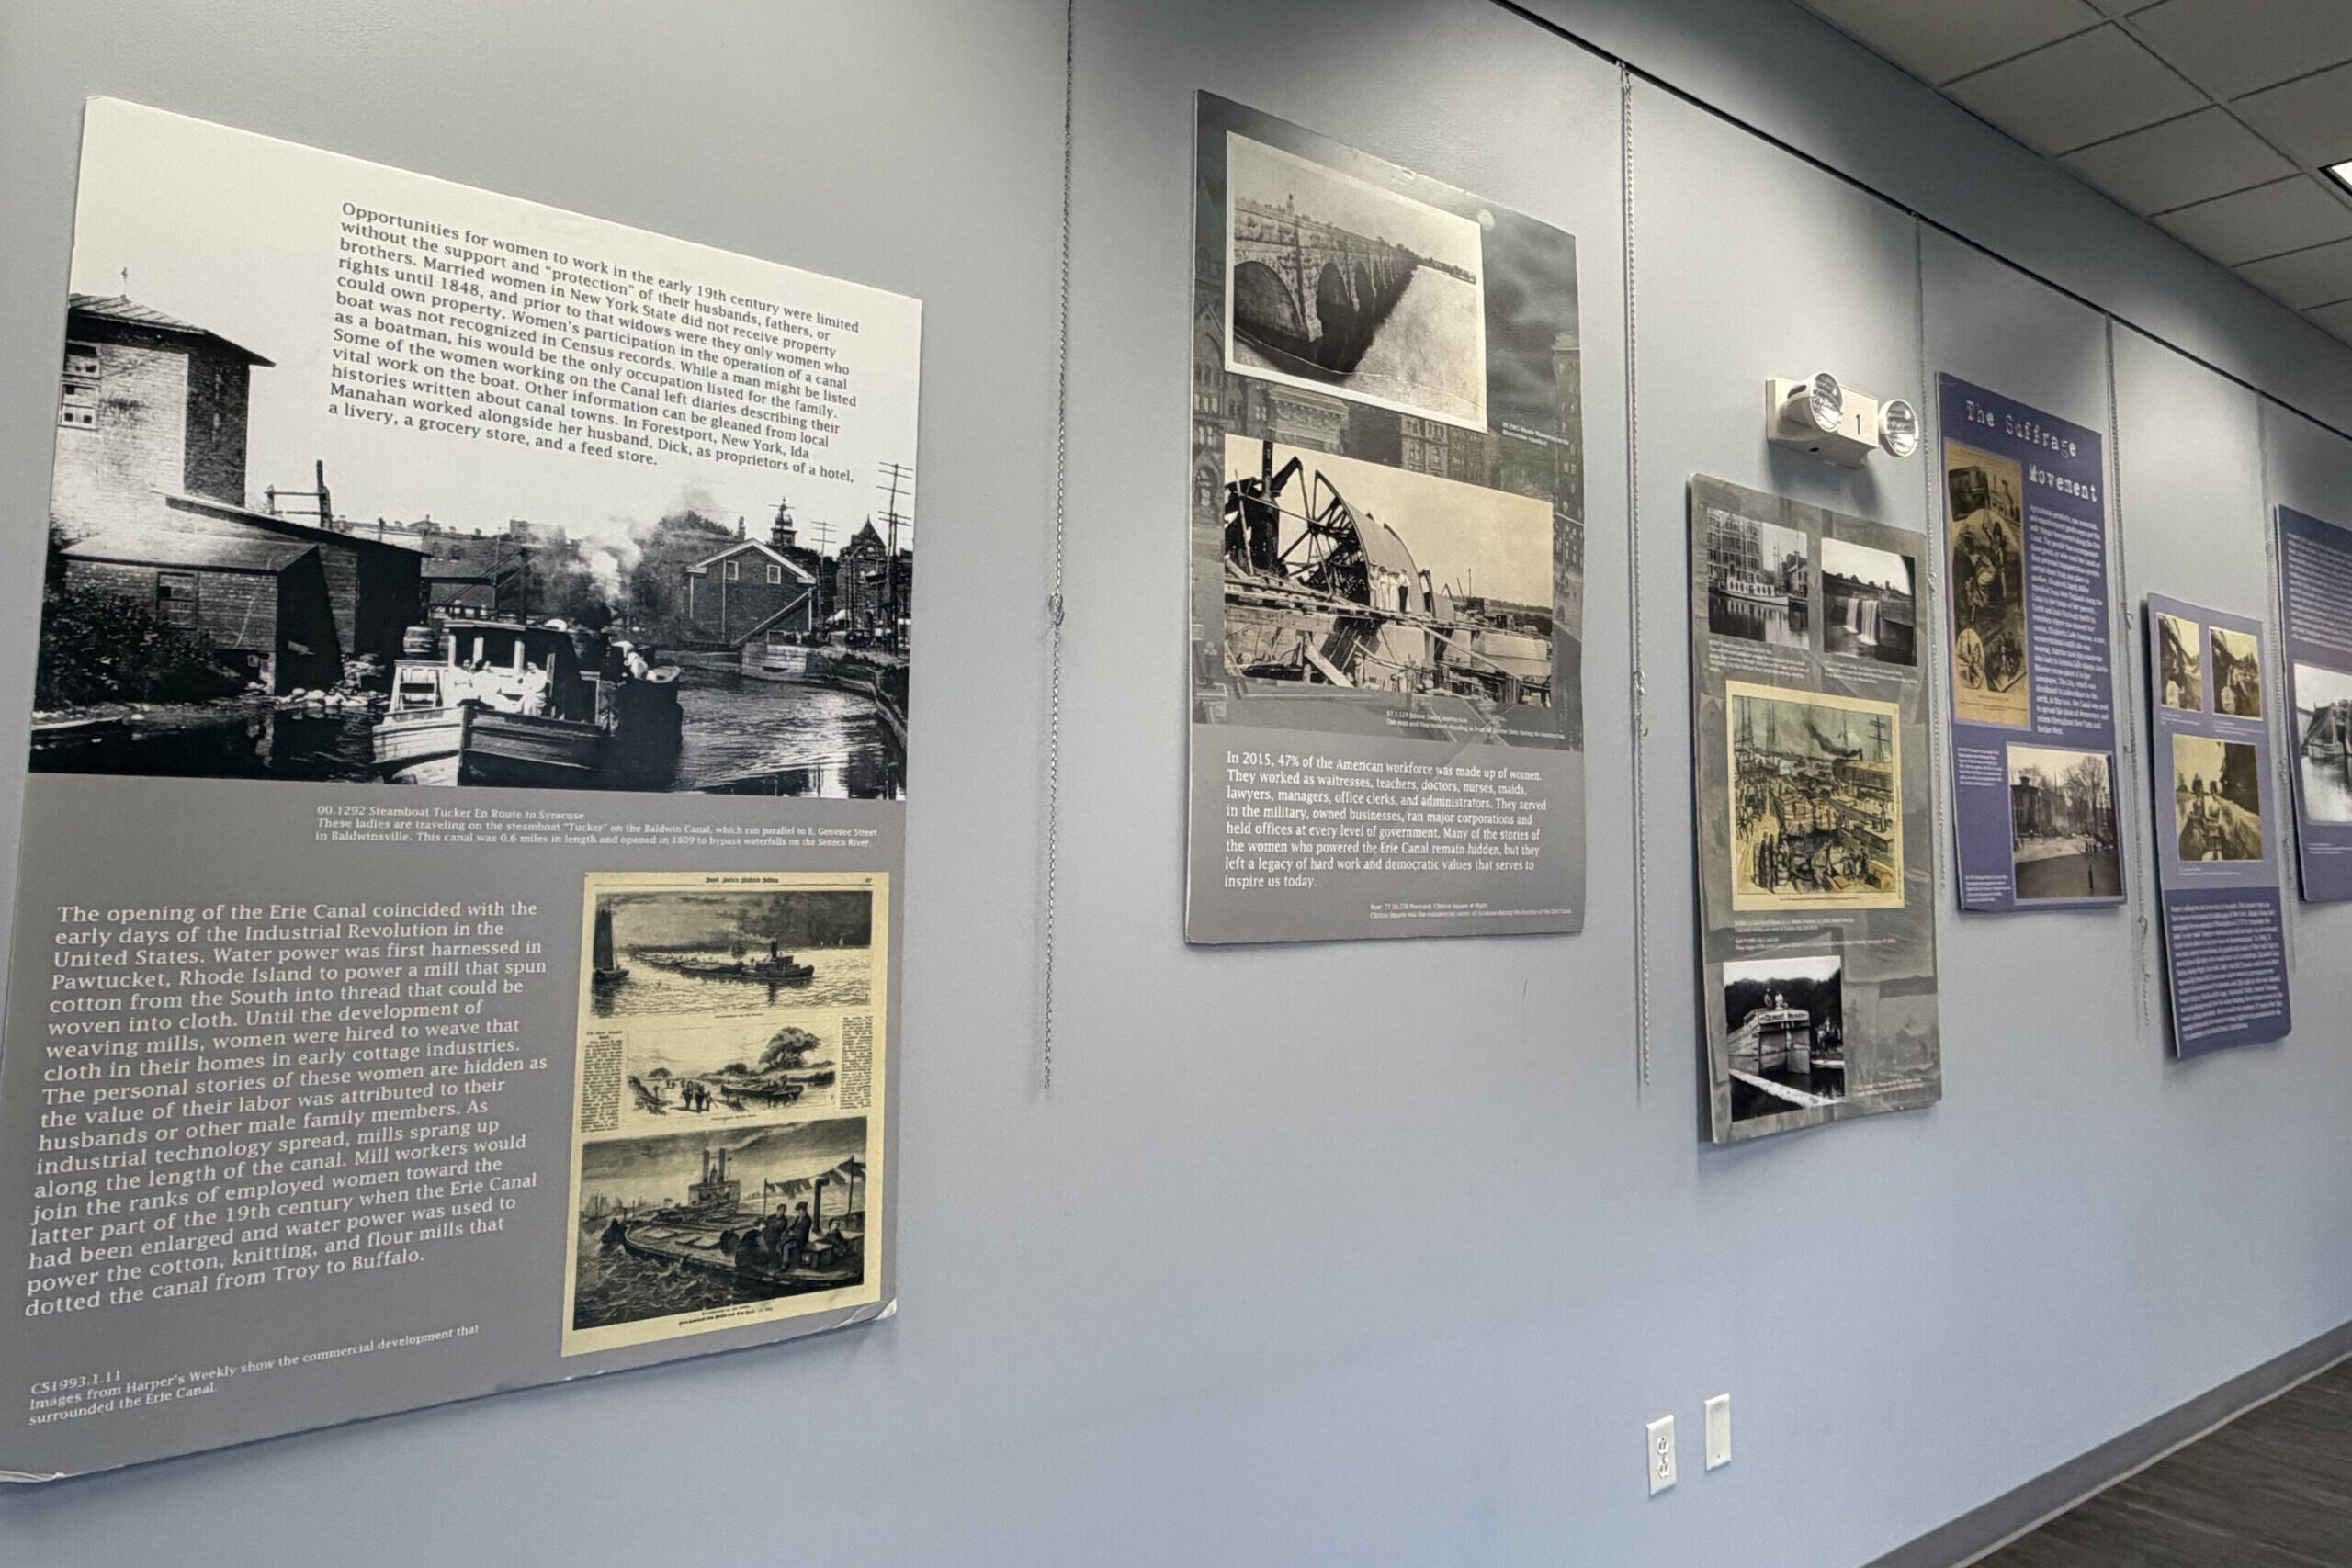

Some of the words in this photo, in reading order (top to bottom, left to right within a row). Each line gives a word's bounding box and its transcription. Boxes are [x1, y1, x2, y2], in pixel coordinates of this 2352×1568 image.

[341, 222, 406, 245] without
[413, 236, 437, 252] the
[445, 245, 505, 267] support
[511, 261, 539, 275] and
[639, 288, 653, 300] of
[658, 292, 690, 309] their
[695, 299, 761, 326] husbands,
[765, 316, 812, 338] fathers,
[817, 331, 830, 341] or
[342, 202, 458, 239] Opportunities
[465, 230, 489, 246] for
[492, 239, 548, 260] women
[553, 252, 568, 265] to
[572, 257, 608, 274] work
[614, 265, 627, 278] in
[632, 270, 653, 285] the
[658, 278, 692, 295] early
[698, 285, 726, 301] 19th
[730, 295, 779, 315] century
[783, 307, 812, 321] were
[816, 312, 858, 333] limited
[337, 276, 384, 295] could
[390, 288, 425, 303] own
[432, 296, 505, 320] property.
[512, 309, 579, 334] Women's
[584, 327, 675, 355] participation
[680, 346, 693, 357] in
[697, 349, 718, 363] the
[722, 356, 784, 377] operation
[788, 369, 801, 380] of
[805, 374, 811, 382] a
[815, 376, 846, 389] canal
[1856, 413, 1861, 435] 1
[1966, 400, 1995, 428] The
[2006, 415, 2076, 458] Suffrage
[2029, 463, 2097, 502] Movement
[1227, 768, 1256, 784] They
[1260, 771, 1299, 784] worked
[1303, 775, 1315, 784] as
[1317, 775, 1374, 788] waitresses,
[1376, 777, 1418, 790] teachers,
[1421, 780, 1460, 793] doctors,
[1463, 784, 1496, 794] nurses,
[319, 818, 352, 828] These
[356, 818, 390, 829] ladies
[415, 821, 465, 831] traveling
[486, 821, 502, 830] the
[506, 822, 560, 831] steamboat
[626, 824, 641, 832] the
[644, 824, 681, 833] Baldwin
[716, 826, 742, 834] which
[763, 827, 795, 836] parallel
[854, 828, 876, 836] Street
[369, 807, 429, 817] Steamboat
[434, 807, 471, 818] Tucker
[475, 808, 488, 818] En
[492, 808, 522, 819] Route
[526, 810, 537, 819] to
[538, 810, 584, 821] Syracuse
[1226, 821, 1251, 834] held
[1255, 822, 1293, 835] offices
[1295, 825, 1306, 835] at
[1308, 826, 1336, 838] every
[1340, 824, 1363, 837] level
[1366, 825, 1376, 837] of
[1379, 829, 1440, 840] government.
[1443, 827, 1468, 840] Many
[1471, 828, 1480, 839] of
[1483, 829, 1497, 840] the
[1499, 830, 1529, 840] stories
[1531, 829, 1540, 840] of
[1227, 805, 1238, 816] in
[1242, 804, 1260, 817] the
[1312, 807, 1346, 819] owned
[1349, 807, 1404, 822] businesses,
[1408, 812, 1423, 821] ran
[1427, 813, 1454, 824] major
[1457, 814, 1514, 825] corporations
[1516, 814, 1532, 825] and
[1224, 875, 1264, 889] inspire
[1268, 877, 1280, 887] us
[1283, 874, 1316, 888] today.
[57, 906, 99, 922] The
[107, 906, 195, 924] opening
[202, 904, 225, 919] of
[232, 904, 262, 919] the
[270, 905, 306, 919] Erie
[313, 902, 366, 919] Canal
[373, 902, 460, 917] coincided
[467, 901, 504, 916] with
[511, 901, 537, 915] the
[52, 971, 170, 990] Pawtucket,
[179, 968, 244, 986] Rhode
[252, 965, 311, 983] Island
[320, 967, 338, 980] to
[345, 966, 402, 982] power
[408, 966, 417, 977] a
[424, 961, 458, 976] mill
[466, 961, 498, 975] that
[505, 962, 546, 976] spun
[48, 1021, 119, 1034] woven
[129, 1017, 172, 1032] into
[179, 1011, 237, 1029] cloth.
[246, 1008, 293, 1025] Until
[301, 1007, 332, 1022] the
[338, 1003, 458, 1021] development
[464, 999, 483, 1014] of
[34, 1179, 97, 1198] along
[107, 1174, 140, 1190] the
[149, 1165, 216, 1187] length
[223, 1161, 245, 1179] of
[253, 1159, 283, 1175] the
[290, 1151, 346, 1171] canal.
[355, 1146, 388, 1165] Mill
[395, 1143, 467, 1160] workers
[473, 1134, 526, 1152] would
[25, 1290, 100, 1316] dotted
[110, 1287, 143, 1304] the
[152, 1275, 207, 1299] canal
[216, 1271, 265, 1290] from
[272, 1264, 319, 1281] Troy
[327, 1260, 345, 1273] to
[352, 1248, 424, 1270] Buffalo.
[30, 1393, 81, 1410] Images
[87, 1387, 120, 1399] from
[189, 1365, 235, 1381] Weekly
[241, 1361, 273, 1372] show
[278, 1356, 299, 1366] the
[302, 1340, 373, 1362] commercial
[377, 1329, 453, 1349] development
[457, 1325, 478, 1336] that
[28, 1400, 113, 1426] surrounded
[119, 1397, 141, 1408] the
[146, 1392, 172, 1404] Erie
